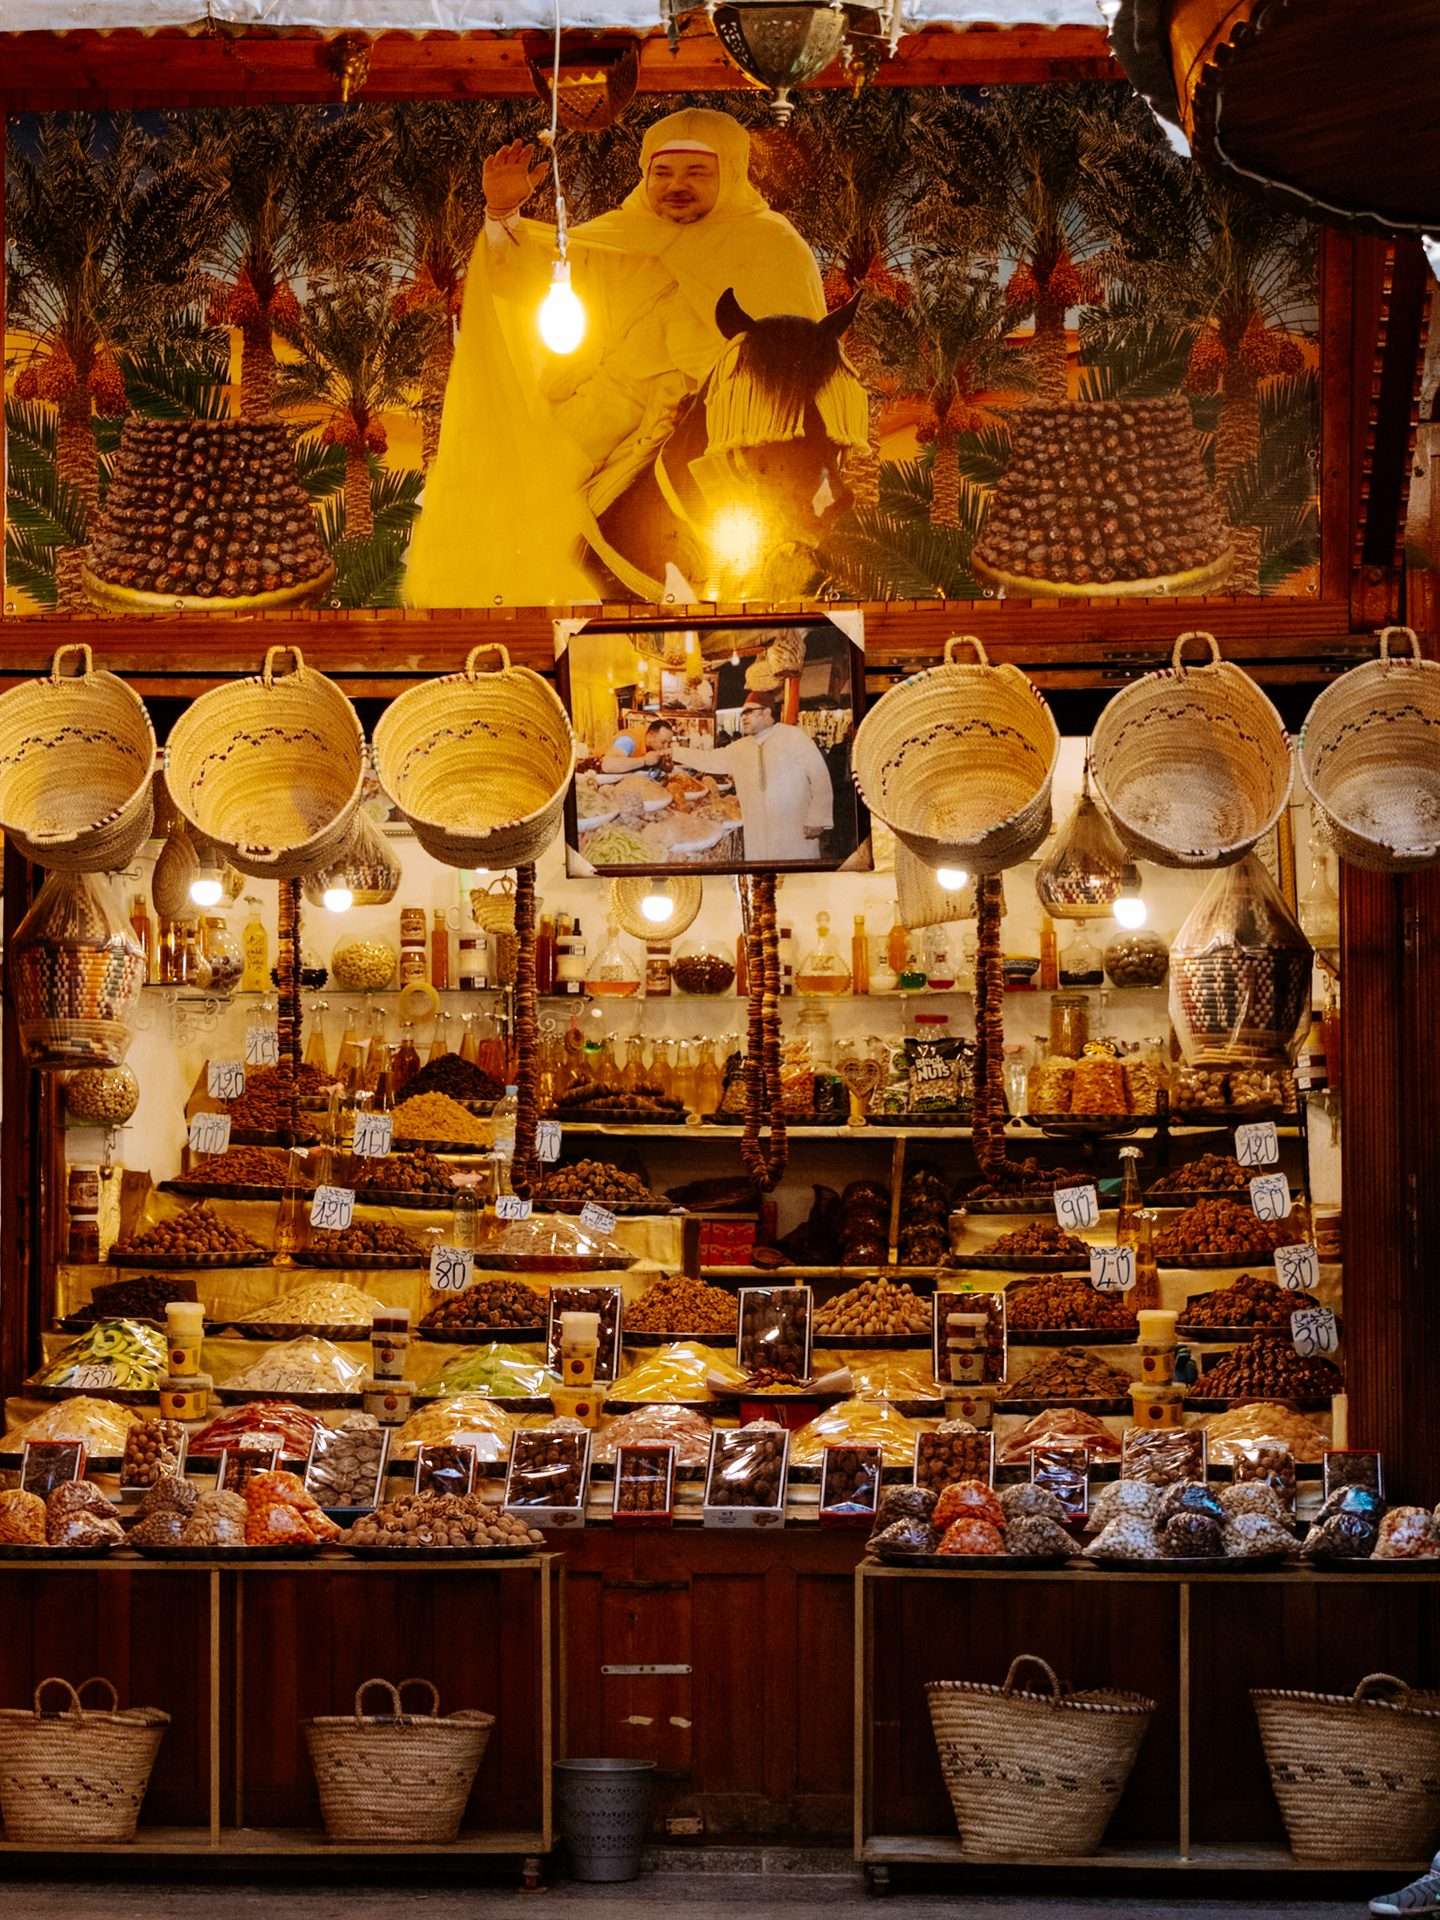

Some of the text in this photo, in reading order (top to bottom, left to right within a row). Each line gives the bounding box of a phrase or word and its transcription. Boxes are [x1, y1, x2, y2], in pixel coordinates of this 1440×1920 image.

[915, 1055, 944, 1068] Black
[917, 1065, 951, 1081] NUTS
[354, 1128, 391, 1154] 160
[1239, 1134, 1277, 1165] 120
[499, 1201, 530, 1218] 150
[1061, 1194, 1091, 1230] 90
[1253, 1188, 1285, 1221] 60
[435, 1260, 466, 1290] 80
[1096, 1255, 1130, 1288] 40
[1282, 1257, 1313, 1290] 80
[1294, 1325, 1331, 1356] 30
